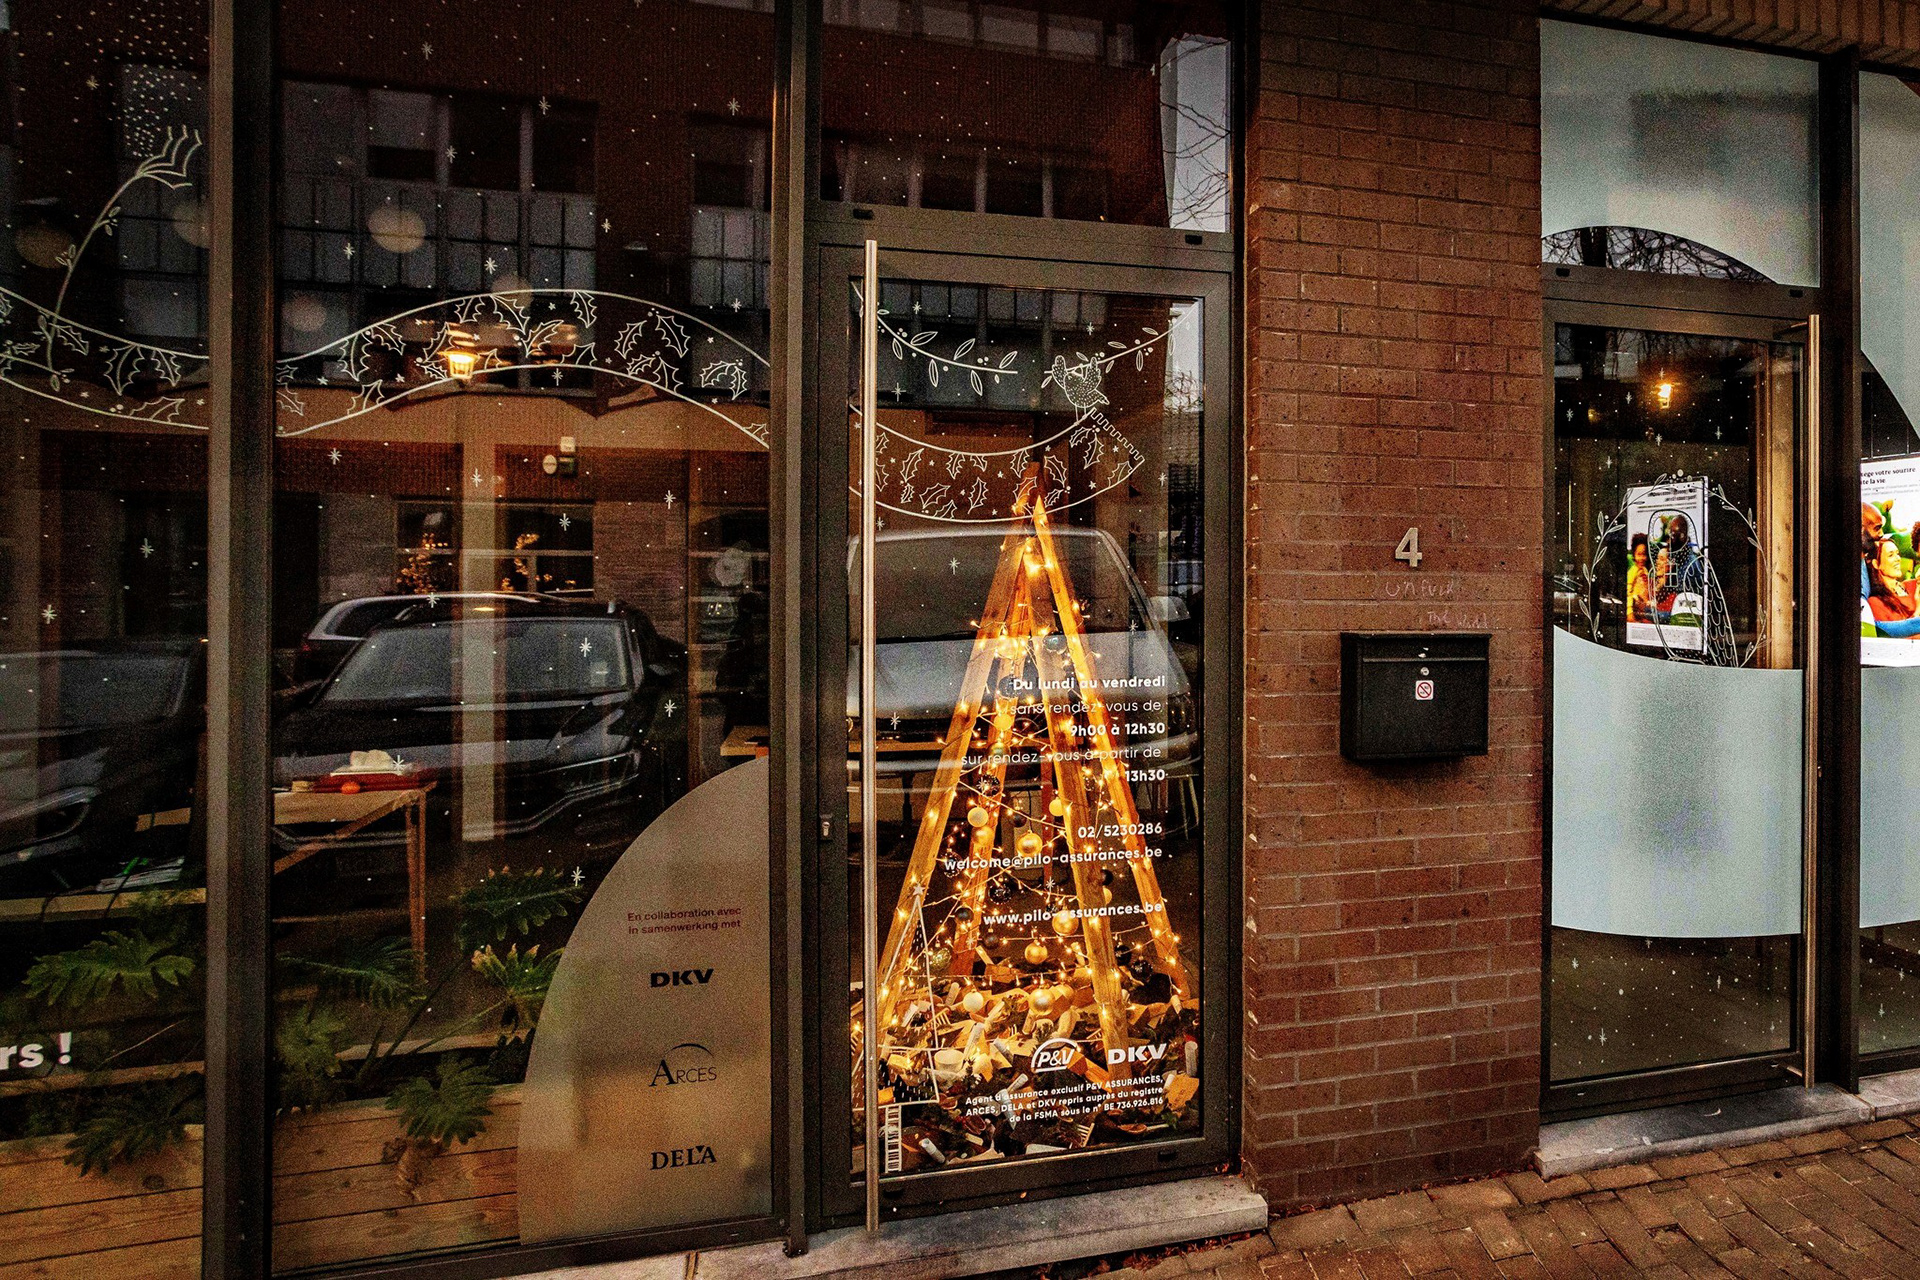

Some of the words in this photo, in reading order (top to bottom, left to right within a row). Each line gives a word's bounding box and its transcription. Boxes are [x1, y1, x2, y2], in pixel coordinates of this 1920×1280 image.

[1395, 527, 1423, 568] 4
[1013, 678, 1033, 690] Du
[1038, 676, 1075, 690] lundi
[1080, 679, 1098, 688] au
[1102, 676, 1166, 688] vendredi
[1010, 704, 1043, 716] sans
[1048, 701, 1138, 714] rendez-vous
[1144, 700, 1162, 712] de
[1070, 724, 1106, 737] 9h00
[1110, 722, 1120, 734] à
[1125, 722, 1166, 735] 12h30
[960, 754, 983, 766] sur
[986, 750, 1080, 764] rendez-vous
[1099, 747, 1138, 762] partir
[1144, 747, 1162, 758] de
[1124, 769, 1166, 782] 13h30
[1077, 822, 1162, 840] 02/5230286
[944, 846, 1162, 871] welcome@pilo-assurances.be
[627, 912, 642, 922] En
[644, 908, 714, 921] collaboration
[717, 907, 742, 917] avec
[983, 901, 1162, 926] www.pilo-assurances.be
[642, 921, 718, 934] samenwerking
[721, 919, 741, 928] met
[650, 968, 714, 988] DKV
[58, 1031, 72, 1065] !
[1037, 1049, 1076, 1068] P&V
[1107, 1043, 1167, 1065] DKV
[965, 1095, 993, 1106] Agent
[1051, 1084, 1084, 1095] exclusif
[1086, 1081, 1102, 1091] P&V
[1105, 1075, 1163, 1088] ASSURANCES,
[966, 1106, 999, 1116] ARCES,
[1001, 1103, 1024, 1113] DELA
[1038, 1098, 1056, 1108] DKV
[1058, 1096, 1083, 1106] repris
[1086, 1091, 1115, 1103] auprès
[1117, 1090, 1129, 1098] du
[1130, 1087, 1163, 1097] registre
[1009, 1115, 1021, 1123] de
[1023, 1113, 1032, 1121] la
[1034, 1110, 1058, 1119] FSMA
[1060, 1107, 1080, 1117] sous
[1104, 1102, 1115, 1111] BE
[650, 1145, 717, 1171] DELA
